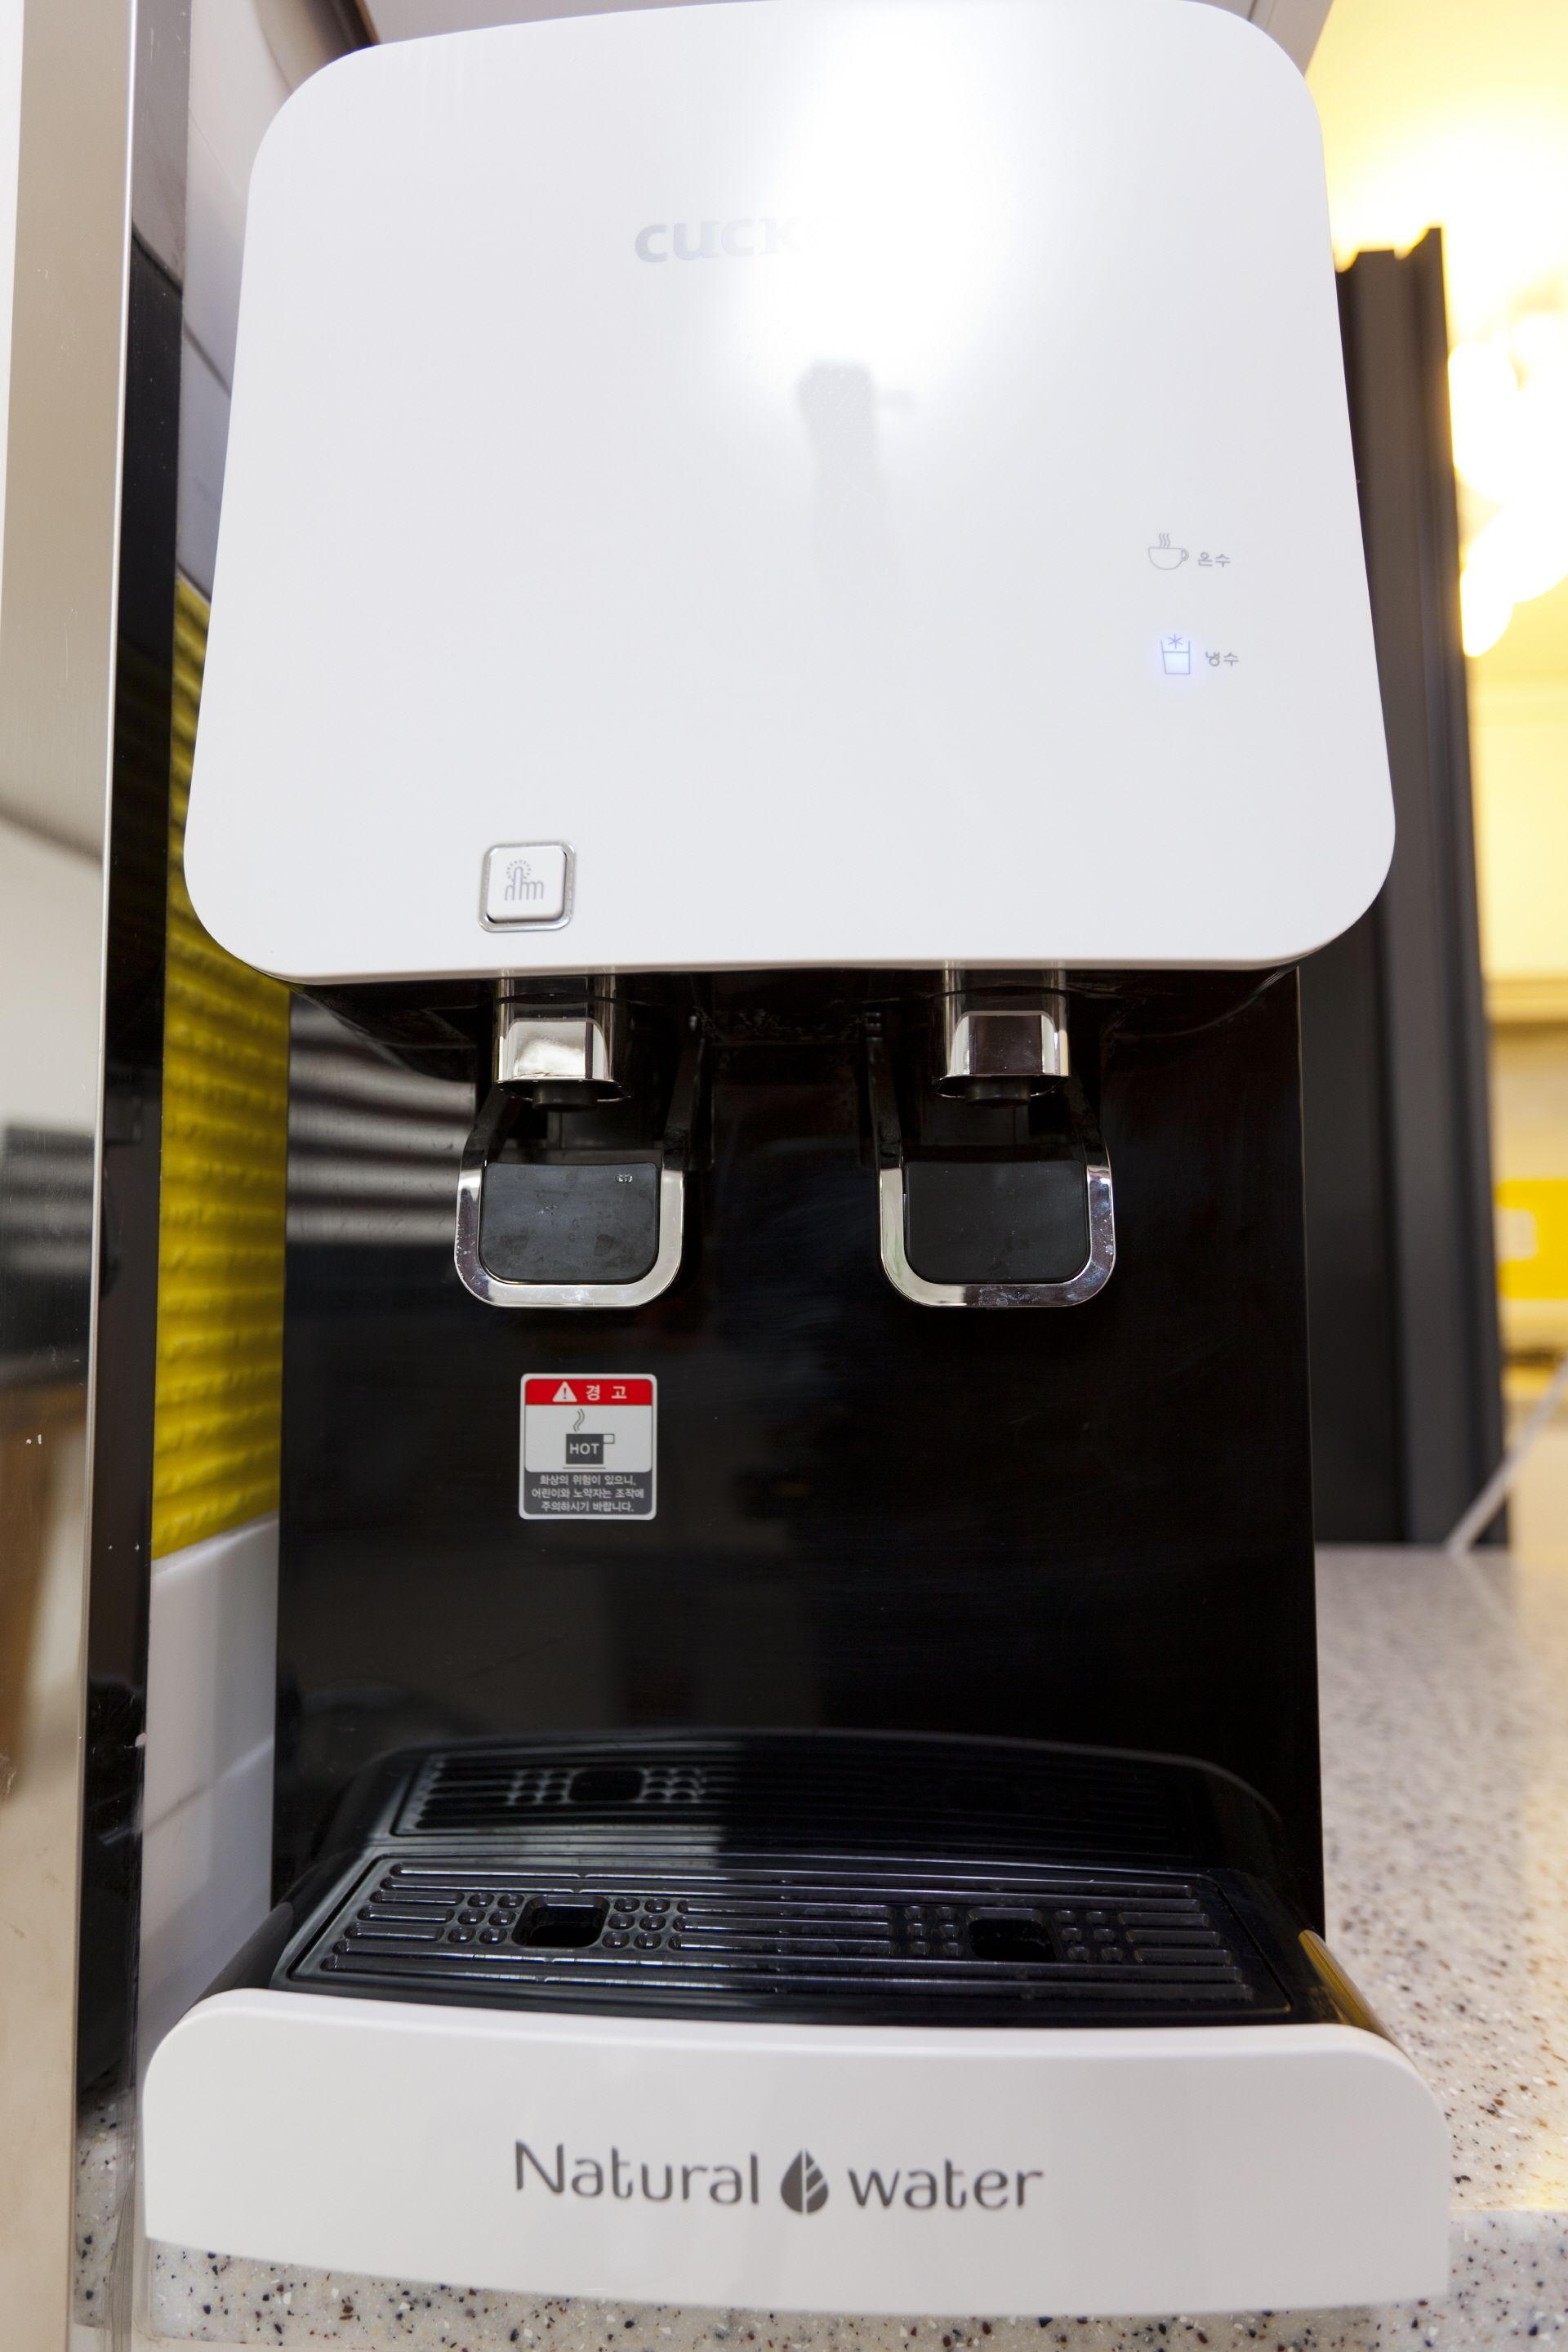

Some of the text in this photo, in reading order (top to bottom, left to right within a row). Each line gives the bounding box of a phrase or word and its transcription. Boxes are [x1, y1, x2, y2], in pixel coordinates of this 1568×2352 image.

[1197, 551, 1231, 568] 온수
[1205, 651, 1239, 667] 냉수
[569, 1443, 599, 1454] HOT
[540, 1475, 568, 1486] 화상의
[572, 1475, 601, 1486] 위험이
[532, 1488, 644, 1499] 어린이와 노약자는 조작에
[541, 1501, 635, 1512] 주의하시기 바랍니다.
[515, 2140, 1045, 2210] Natural water
